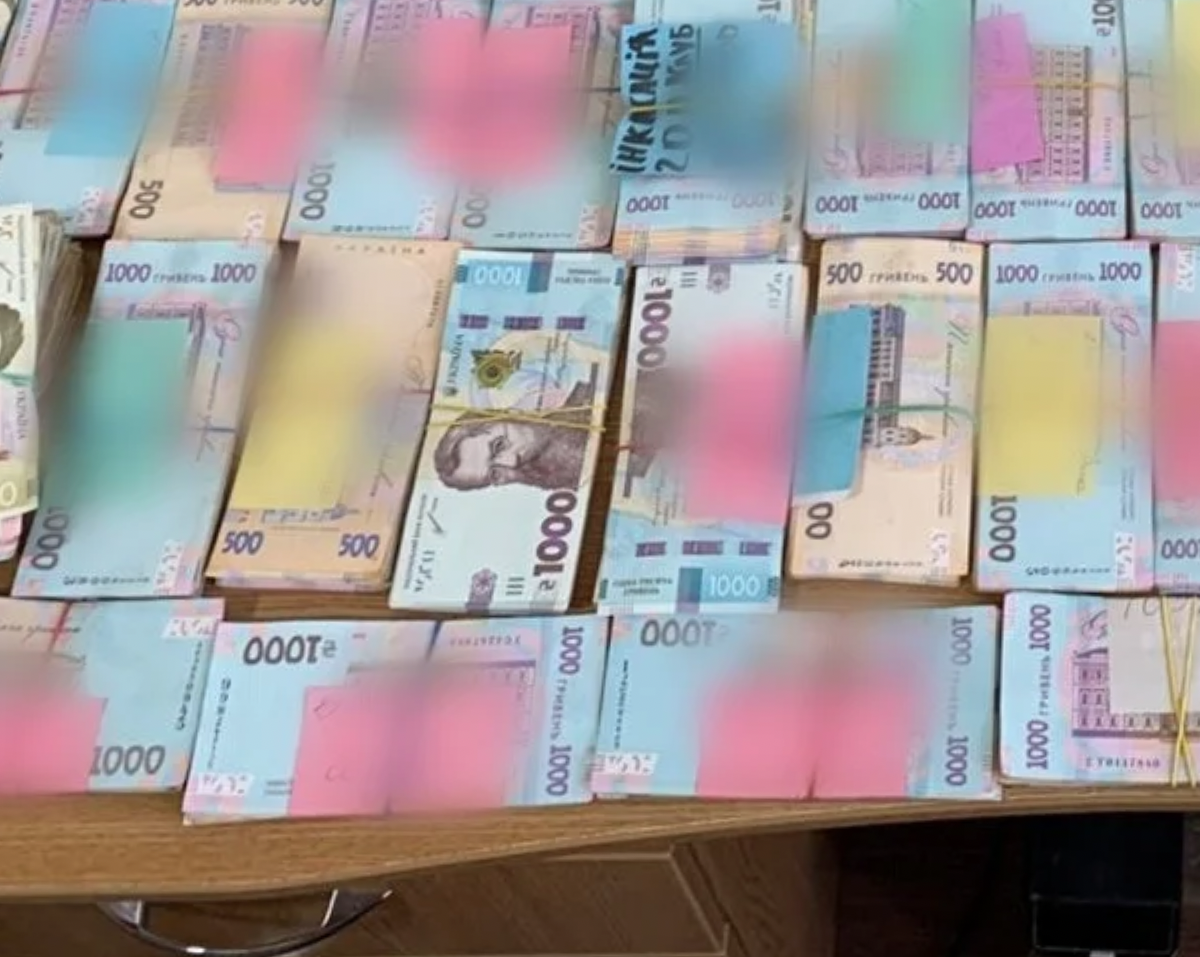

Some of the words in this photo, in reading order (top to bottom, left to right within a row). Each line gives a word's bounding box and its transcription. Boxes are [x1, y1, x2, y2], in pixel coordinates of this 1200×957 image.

[128, 180, 164, 220] 500
[626, 196, 670, 213] 1000
[815, 196, 858, 214] 1000
[918, 192, 960, 210] 1000
[974, 201, 1016, 219] 1000
[1075, 199, 1118, 218] 1000
[1141, 201, 1183, 220] 1000
[105, 263, 151, 282] 1000
[210, 262, 256, 282] 1000
[474, 266, 523, 284] 1000
[826, 262, 864, 285] 500
[869, 272, 929, 284] ГРИВЕНЬ
[935, 262, 973, 284] 500
[995, 264, 1039, 284] 1000
[1099, 261, 1142, 281] 1000
[805, 501, 834, 540] 00
[989, 495, 1018, 563] 1000
[222, 531, 264, 555] 500
[338, 533, 380, 558] 500
[709, 576, 761, 595] 1000
[1029, 603, 1052, 652] 1000
[559, 625, 585, 676] 1000
[951, 615, 974, 667] 1000
[1040, 655, 1051, 718] ГРИВЕНЬ
[1026, 720, 1049, 771] 1000
[88, 744, 166, 776] 1000
[545, 743, 573, 798] 1000
[944, 734, 970, 787] 1000
